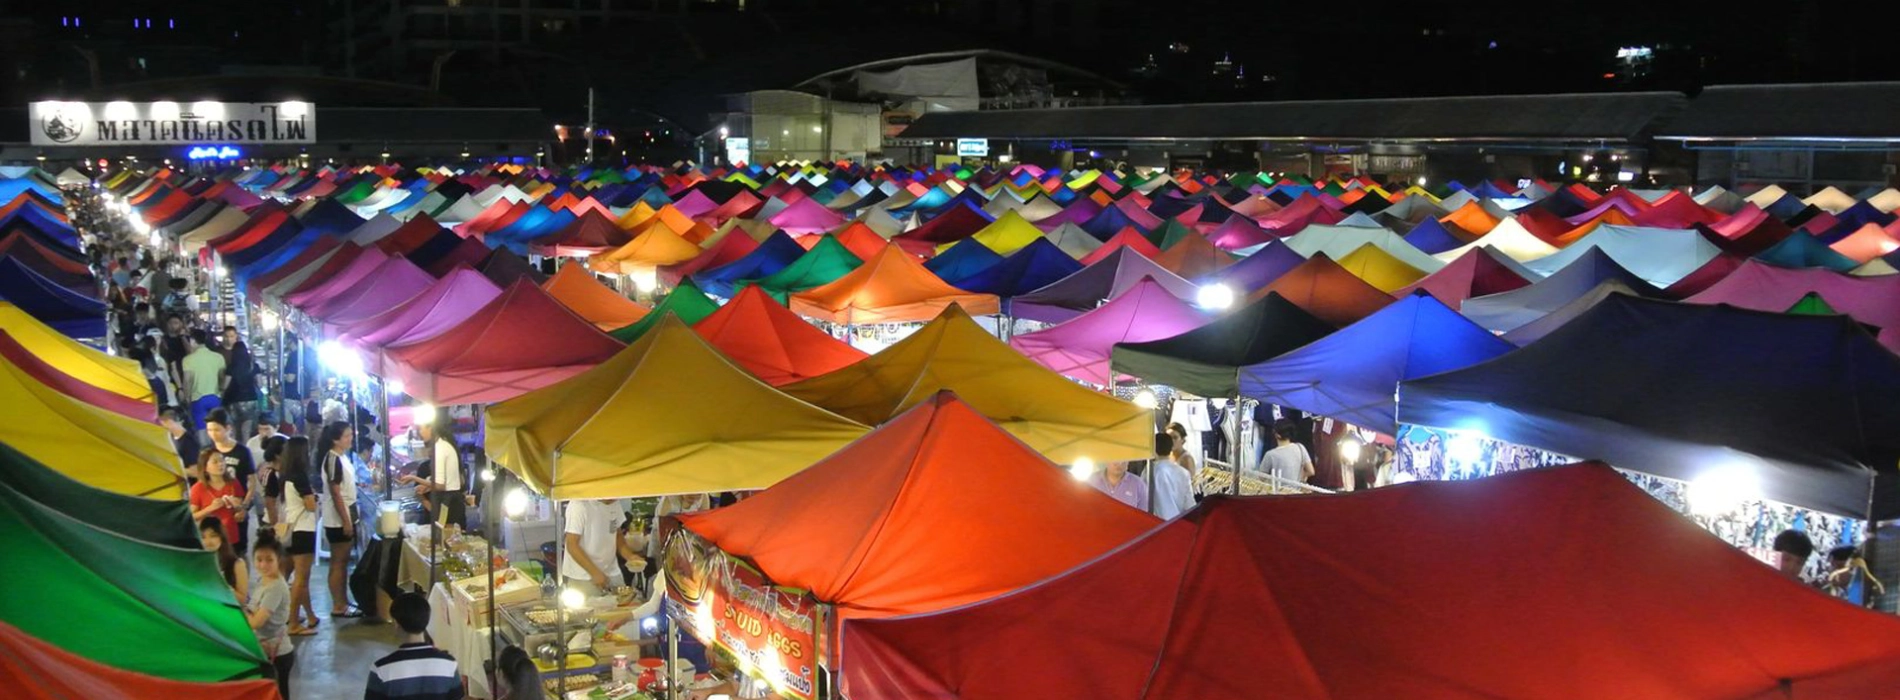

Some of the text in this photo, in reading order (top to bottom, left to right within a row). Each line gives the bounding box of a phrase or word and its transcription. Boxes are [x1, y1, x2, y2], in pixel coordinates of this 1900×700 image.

[97, 105, 307, 141] ตลาดนัดรถไฟ
[724, 602, 762, 637] SUID
